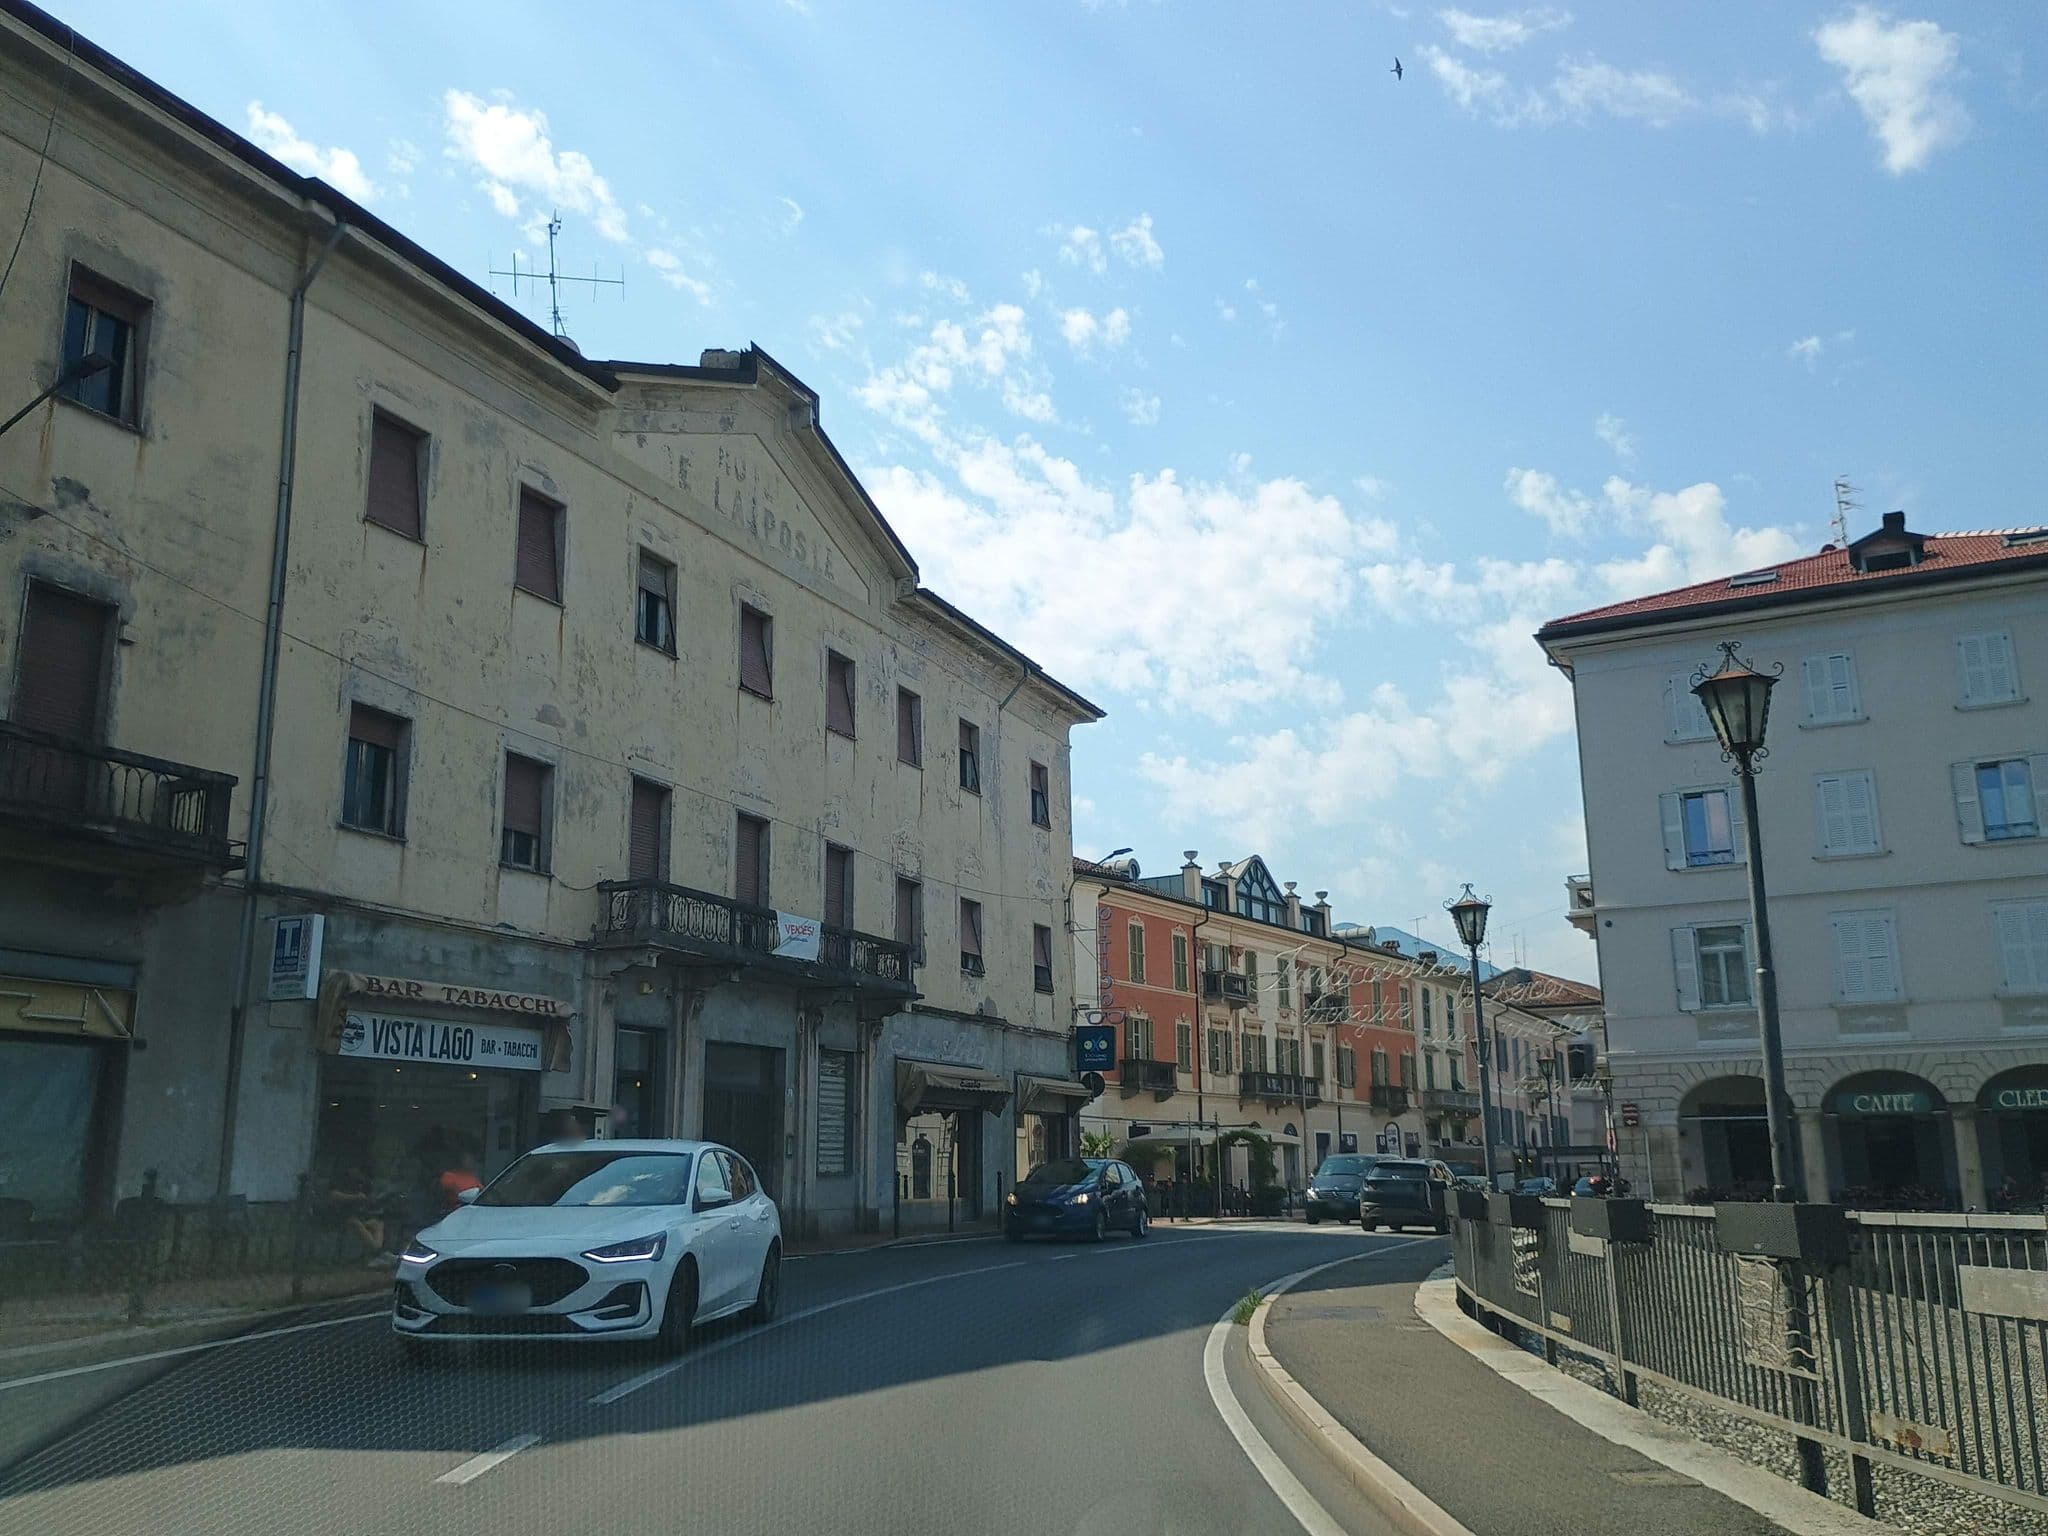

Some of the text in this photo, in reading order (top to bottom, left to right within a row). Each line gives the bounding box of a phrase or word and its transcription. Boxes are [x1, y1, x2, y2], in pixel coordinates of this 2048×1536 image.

[366, 976, 557, 1014] BAR TABACCHI
[372, 1018, 424, 1058] VISTA
[428, 1024, 474, 1061] LAGO
[480, 1038, 497, 1055] BAR
[503, 1041, 538, 1058] TABACCHI
